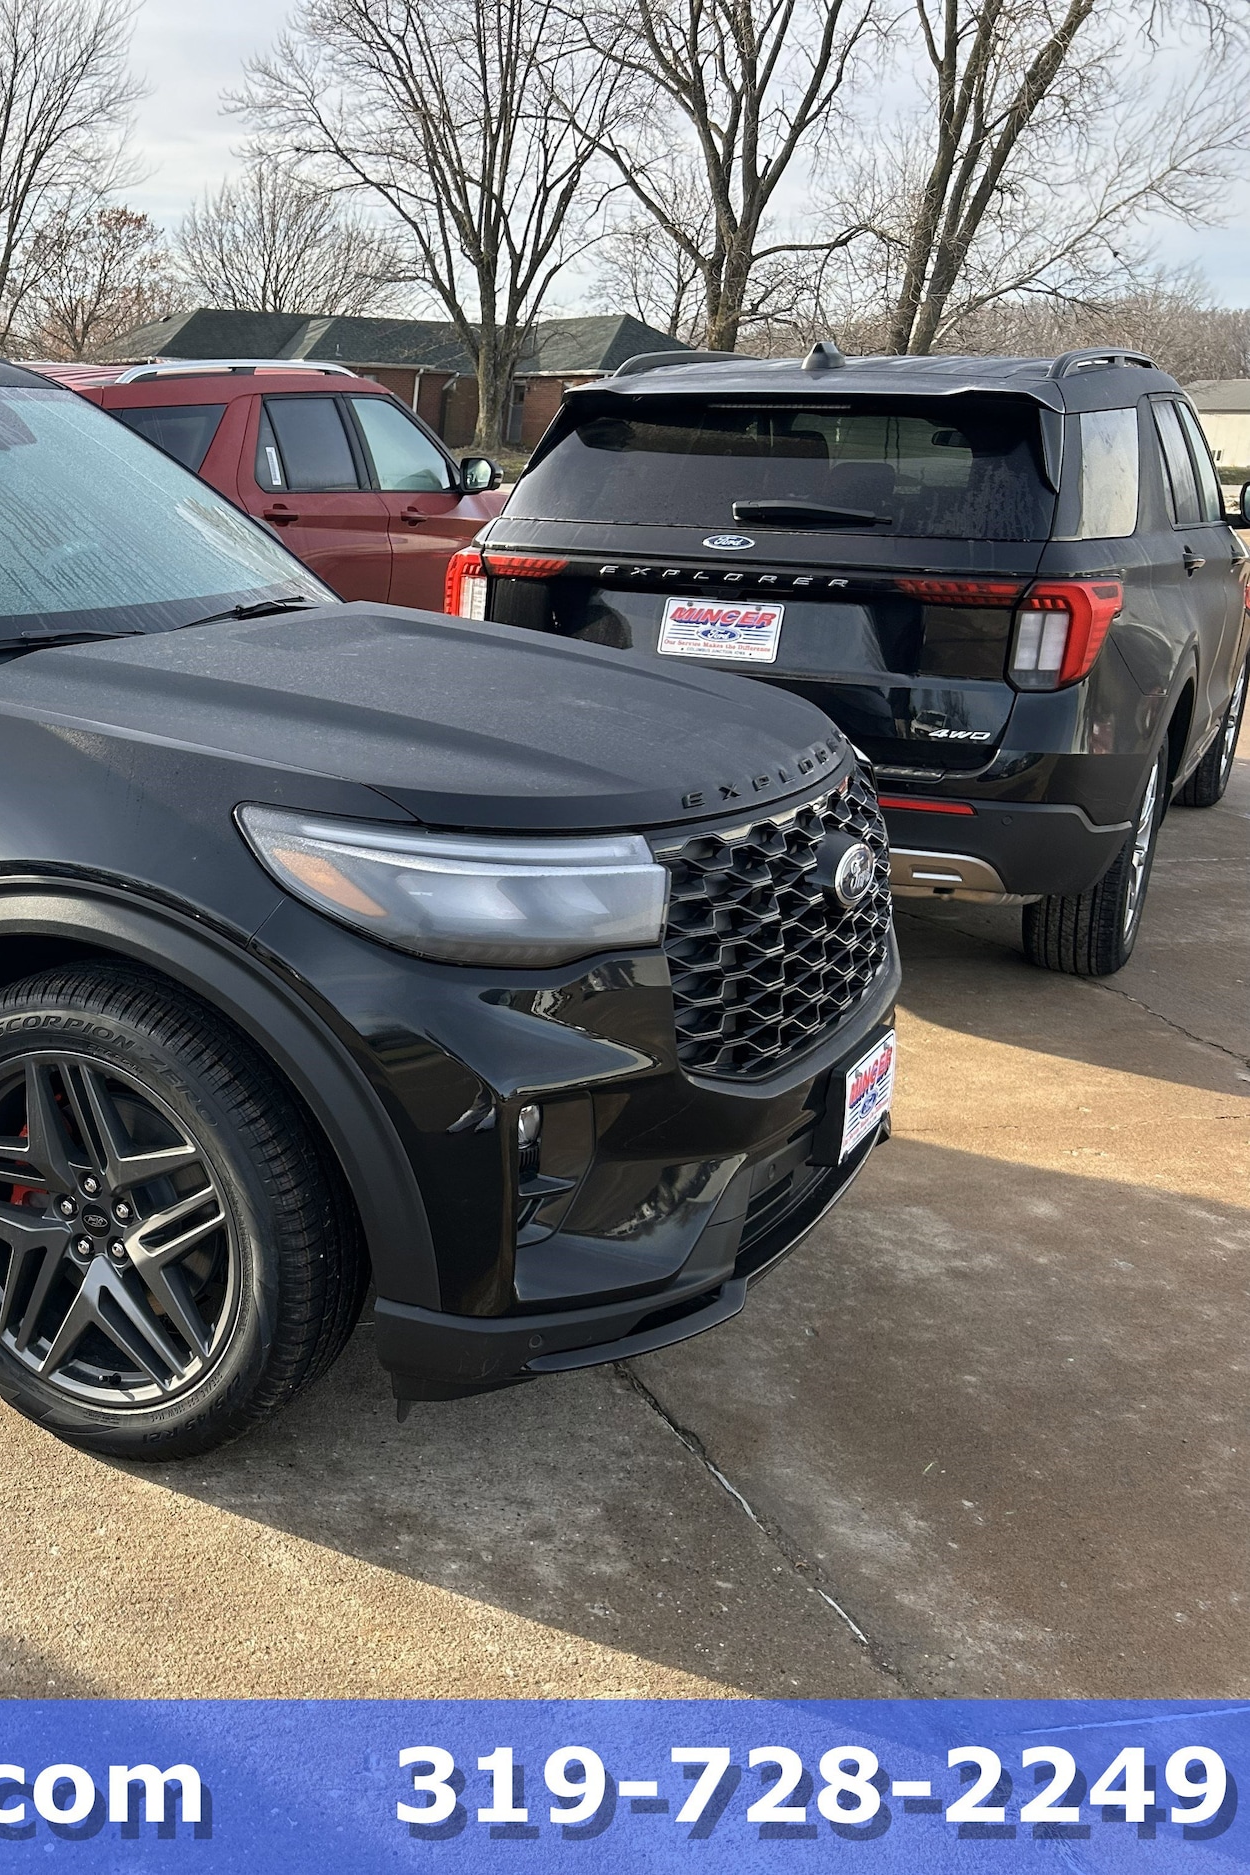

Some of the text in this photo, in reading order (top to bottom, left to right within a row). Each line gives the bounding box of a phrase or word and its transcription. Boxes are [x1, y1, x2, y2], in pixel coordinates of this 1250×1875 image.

[711, 535, 748, 549] Ford
[600, 565, 849, 588] EXPLORER
[670, 606, 777, 628] MINCER
[677, 640, 701, 648] Service
[725, 642, 736, 650] the
[737, 643, 771, 653] Difference
[928, 729, 991, 740] 4WD
[141, 1053, 219, 1127] ZERO
